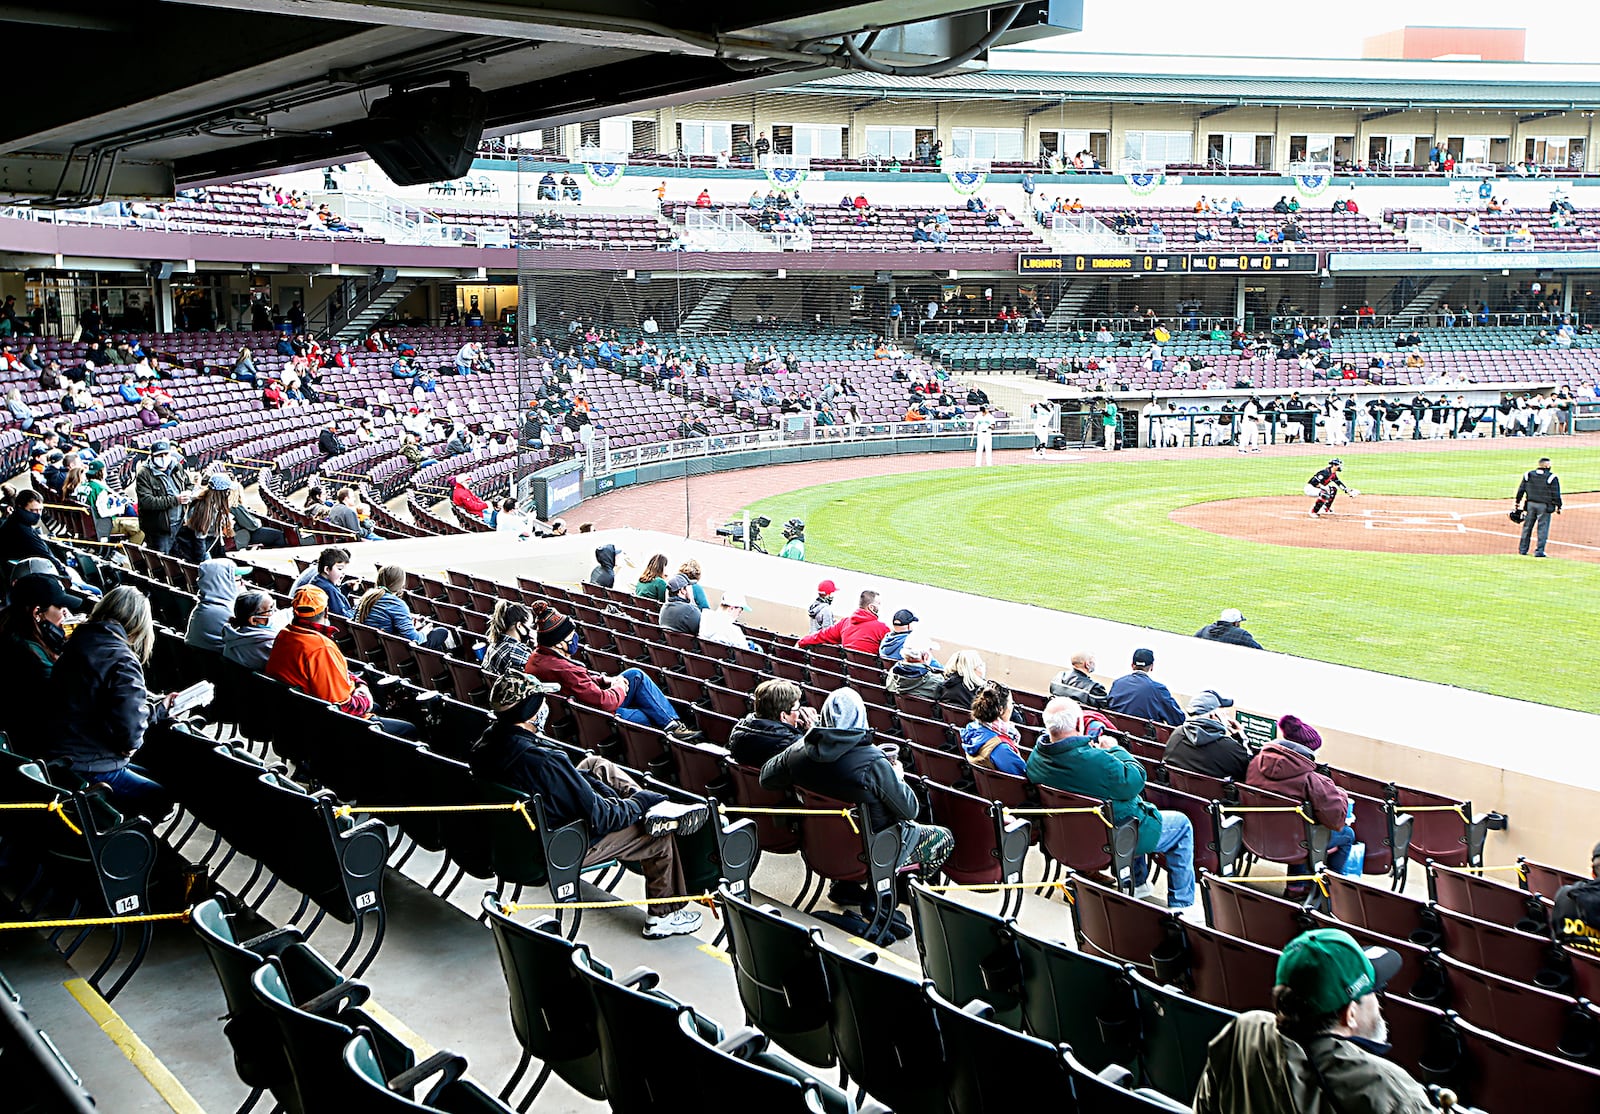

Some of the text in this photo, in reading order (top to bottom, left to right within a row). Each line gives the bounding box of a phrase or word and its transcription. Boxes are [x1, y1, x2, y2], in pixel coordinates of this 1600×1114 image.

[1023, 258, 1063, 269] LUGNUTS
[1076, 256, 1085, 271] 0
[1092, 258, 1132, 268] DRAGONS
[1143, 256, 1153, 271] 0
[562, 885, 570, 895] 12
[121, 898, 134, 910] 14
[361, 894, 371, 905] 13
